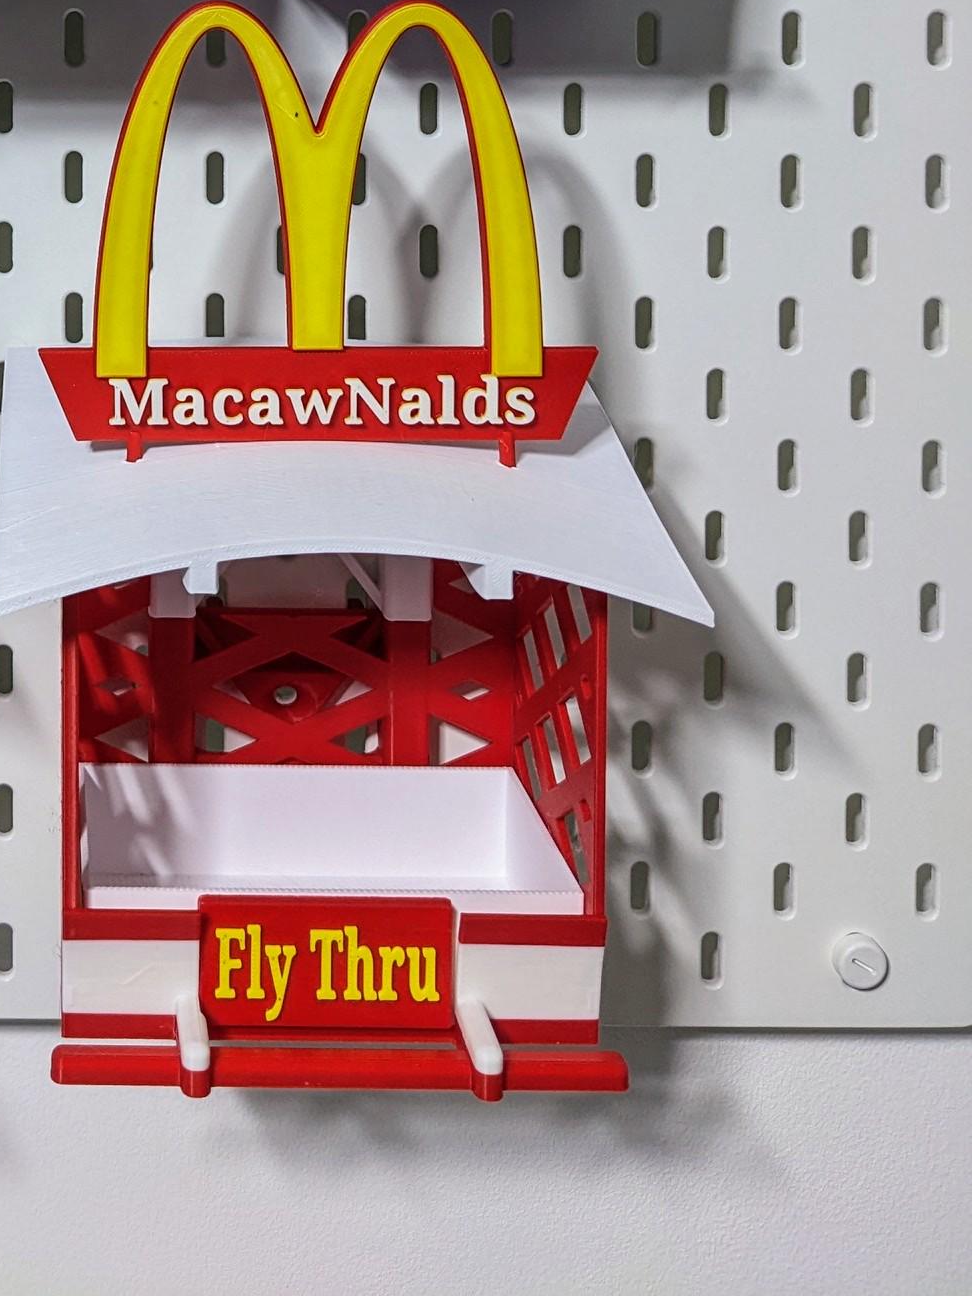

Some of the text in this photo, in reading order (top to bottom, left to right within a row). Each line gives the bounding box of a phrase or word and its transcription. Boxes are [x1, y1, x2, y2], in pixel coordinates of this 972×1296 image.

[107, 373, 536, 428] MacawNalds
[214, 923, 441, 1023] Fly Thru
